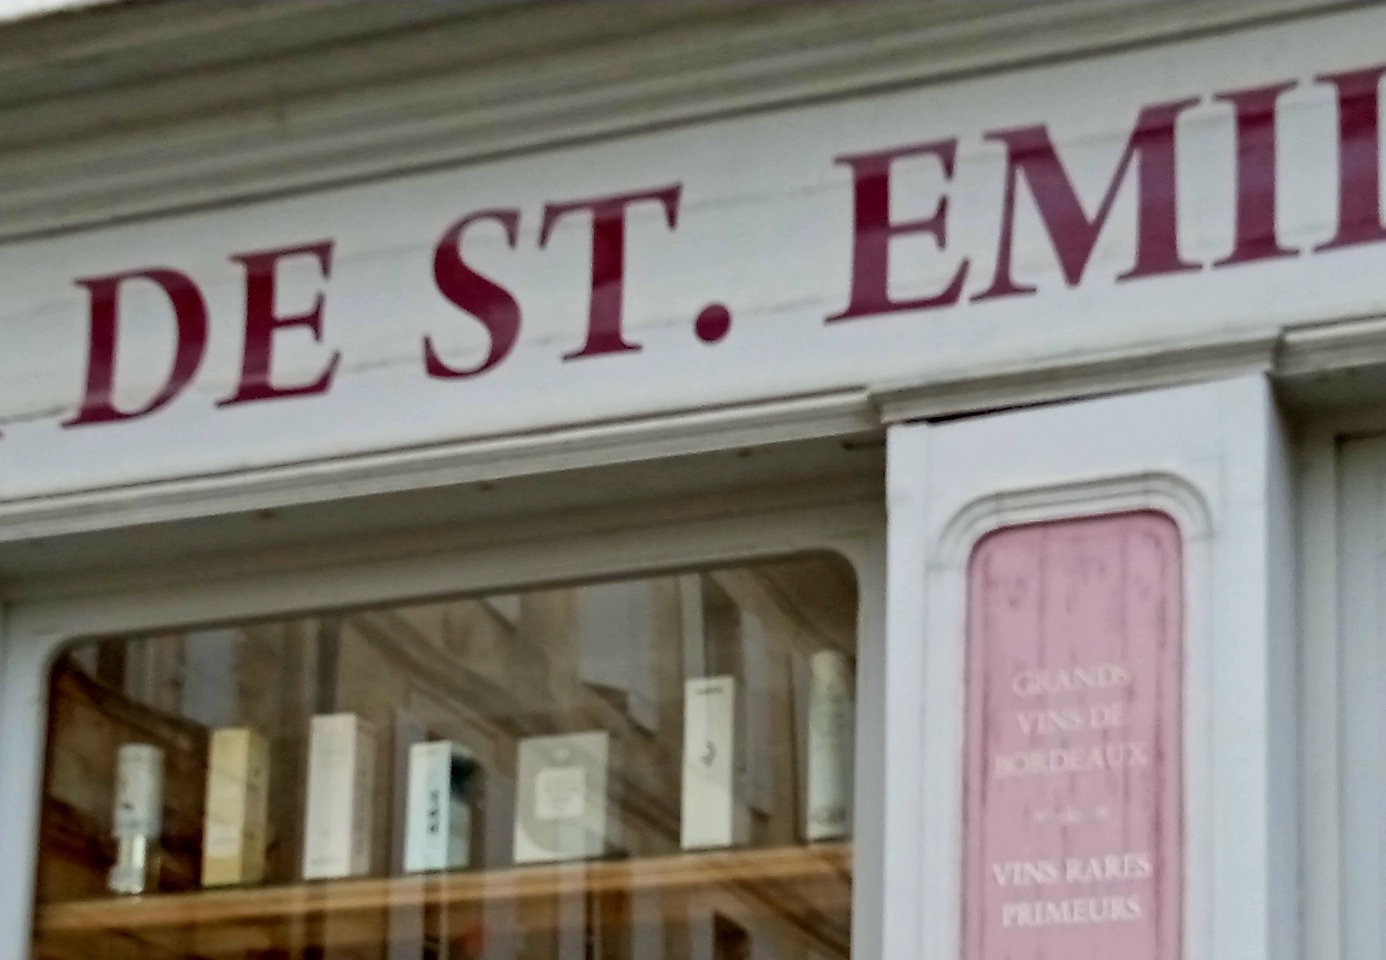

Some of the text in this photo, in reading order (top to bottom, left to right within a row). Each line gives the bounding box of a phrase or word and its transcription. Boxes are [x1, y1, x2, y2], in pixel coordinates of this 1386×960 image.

[61, 238, 341, 429] DE
[422, 183, 732, 380] ST.
[1013, 664, 1132, 696] GRANDS
[1017, 704, 1123, 735] VINS DE
[995, 742, 1149, 778] BORDEAUX
[993, 853, 1153, 887] VINS RARES
[1002, 896, 1142, 928] PRIMEURS
